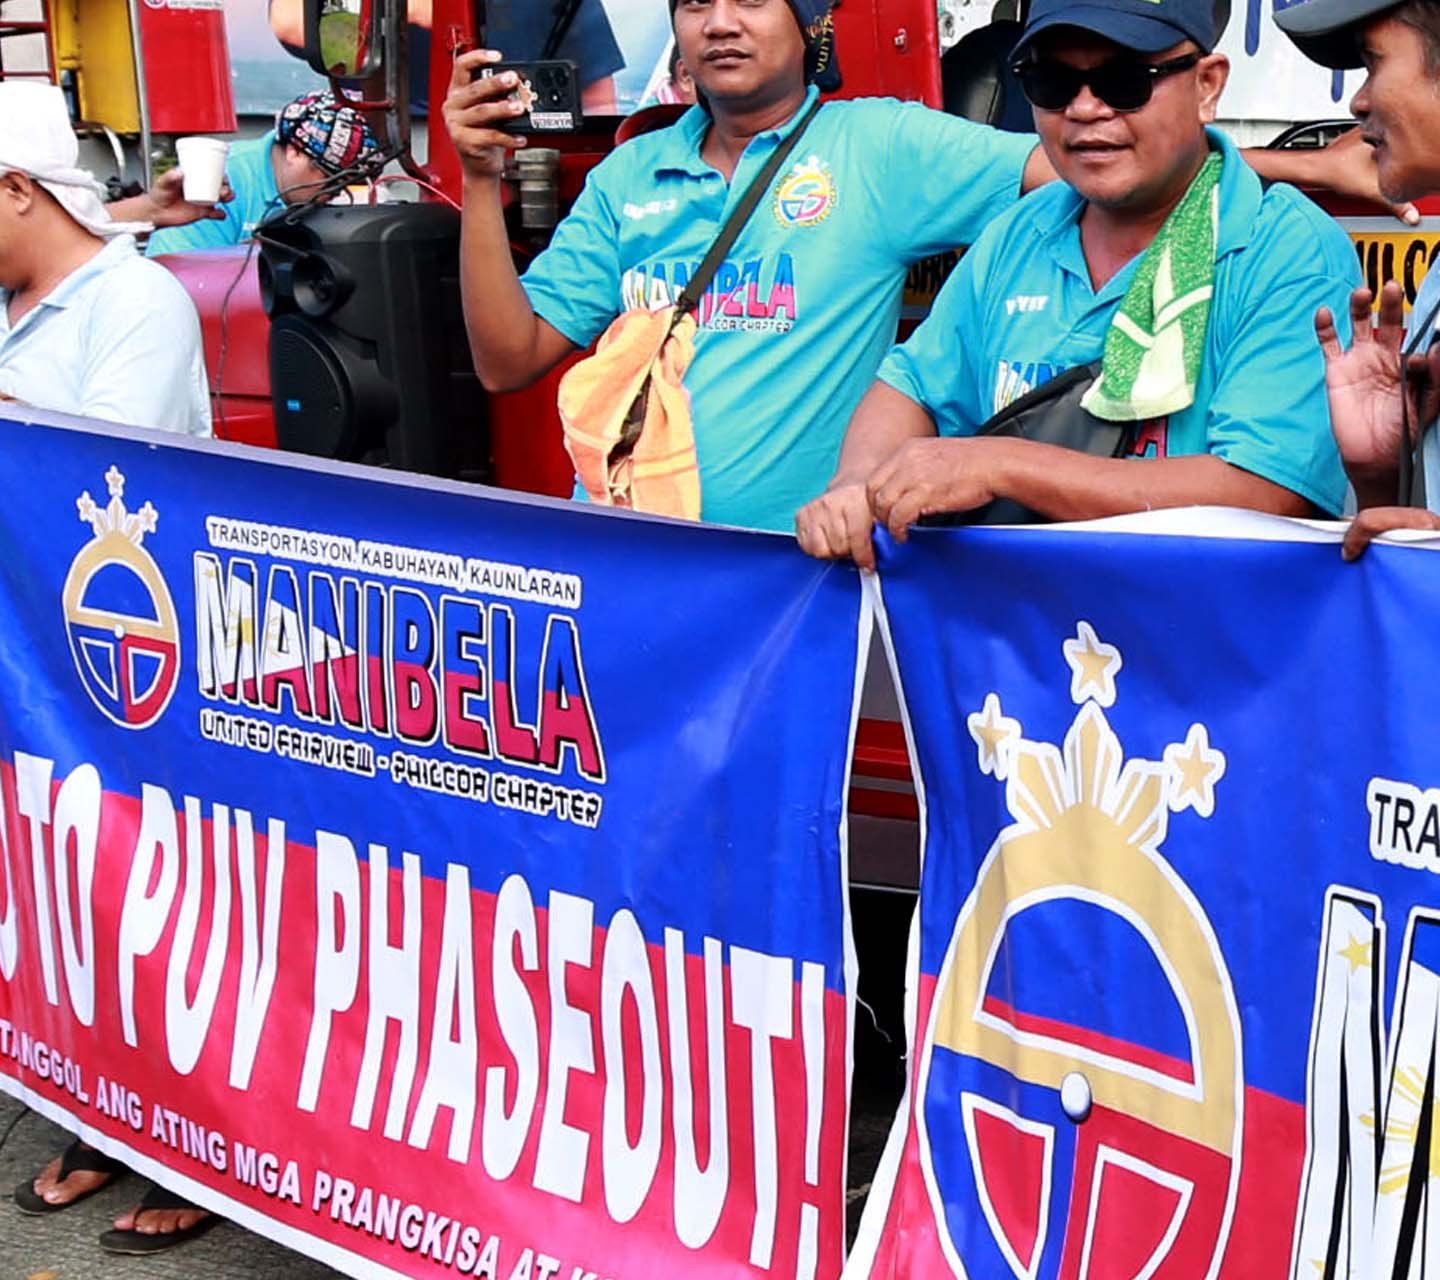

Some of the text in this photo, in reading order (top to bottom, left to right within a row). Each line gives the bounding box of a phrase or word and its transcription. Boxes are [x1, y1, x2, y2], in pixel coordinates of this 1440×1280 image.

[361, 548, 464, 584] KABUHAYAN,
[471, 565, 577, 602] KAUNLARAN
[195, 551, 606, 783] MANIBELA
[201, 712, 271, 750] UNITED
[277, 725, 373, 773] FAIRVIEW
[392, 753, 487, 801] PHILCOA
[492, 776, 601, 828] CHAPTER
[15, 750, 103, 1027] TO
[118, 782, 286, 1091] PUV
[96, 1075, 143, 1131] ANG
[152, 1103, 227, 1172] ATING
[234, 1142, 302, 1205] MGA
